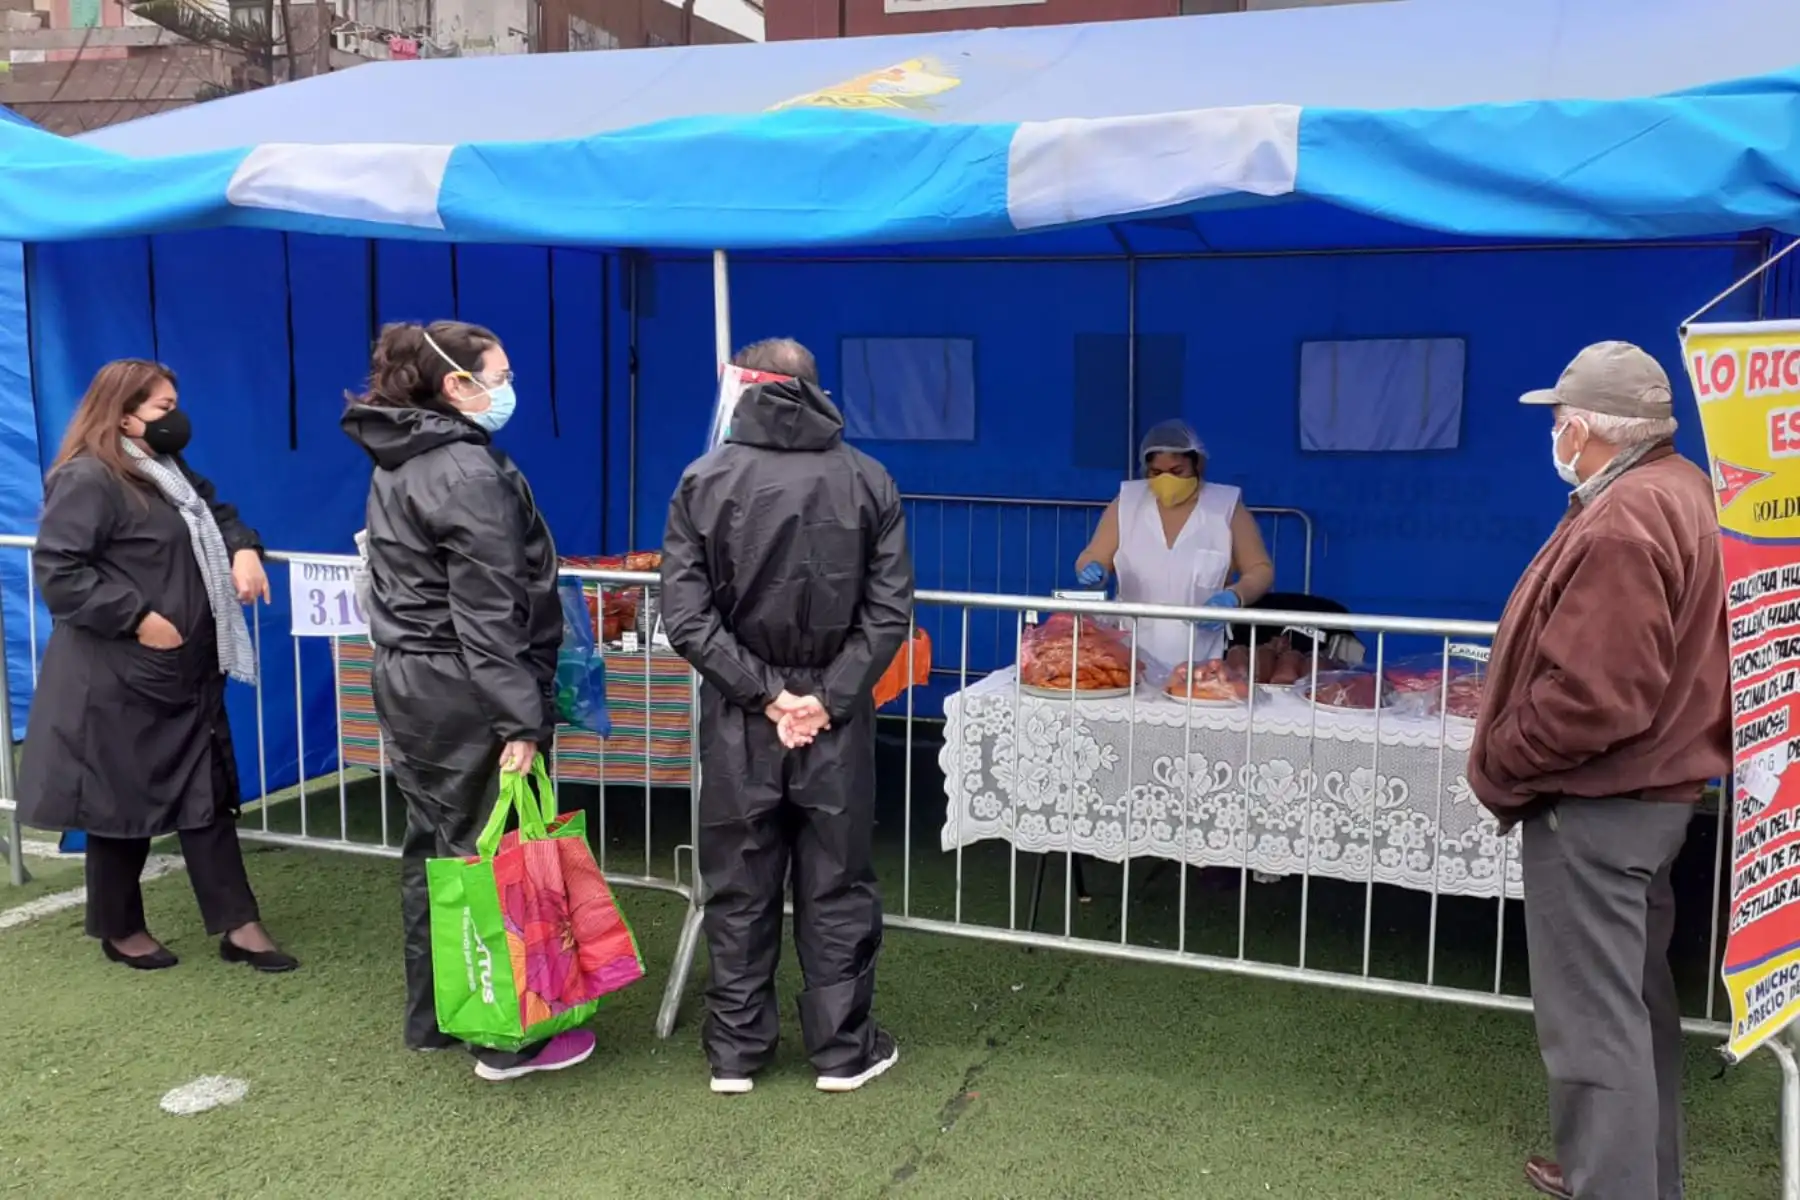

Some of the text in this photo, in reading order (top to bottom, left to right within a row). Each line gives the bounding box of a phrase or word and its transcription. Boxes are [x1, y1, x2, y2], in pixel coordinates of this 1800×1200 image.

[1694, 353, 1736, 396] LO
[1753, 496, 1800, 523] GOLD
[303, 563, 352, 581] OFERT
[1780, 671, 1795, 692] LA
[1770, 812, 1790, 838] DEL
[1771, 848, 1785, 873] DE
[1747, 991, 1785, 1030] PRECIO
